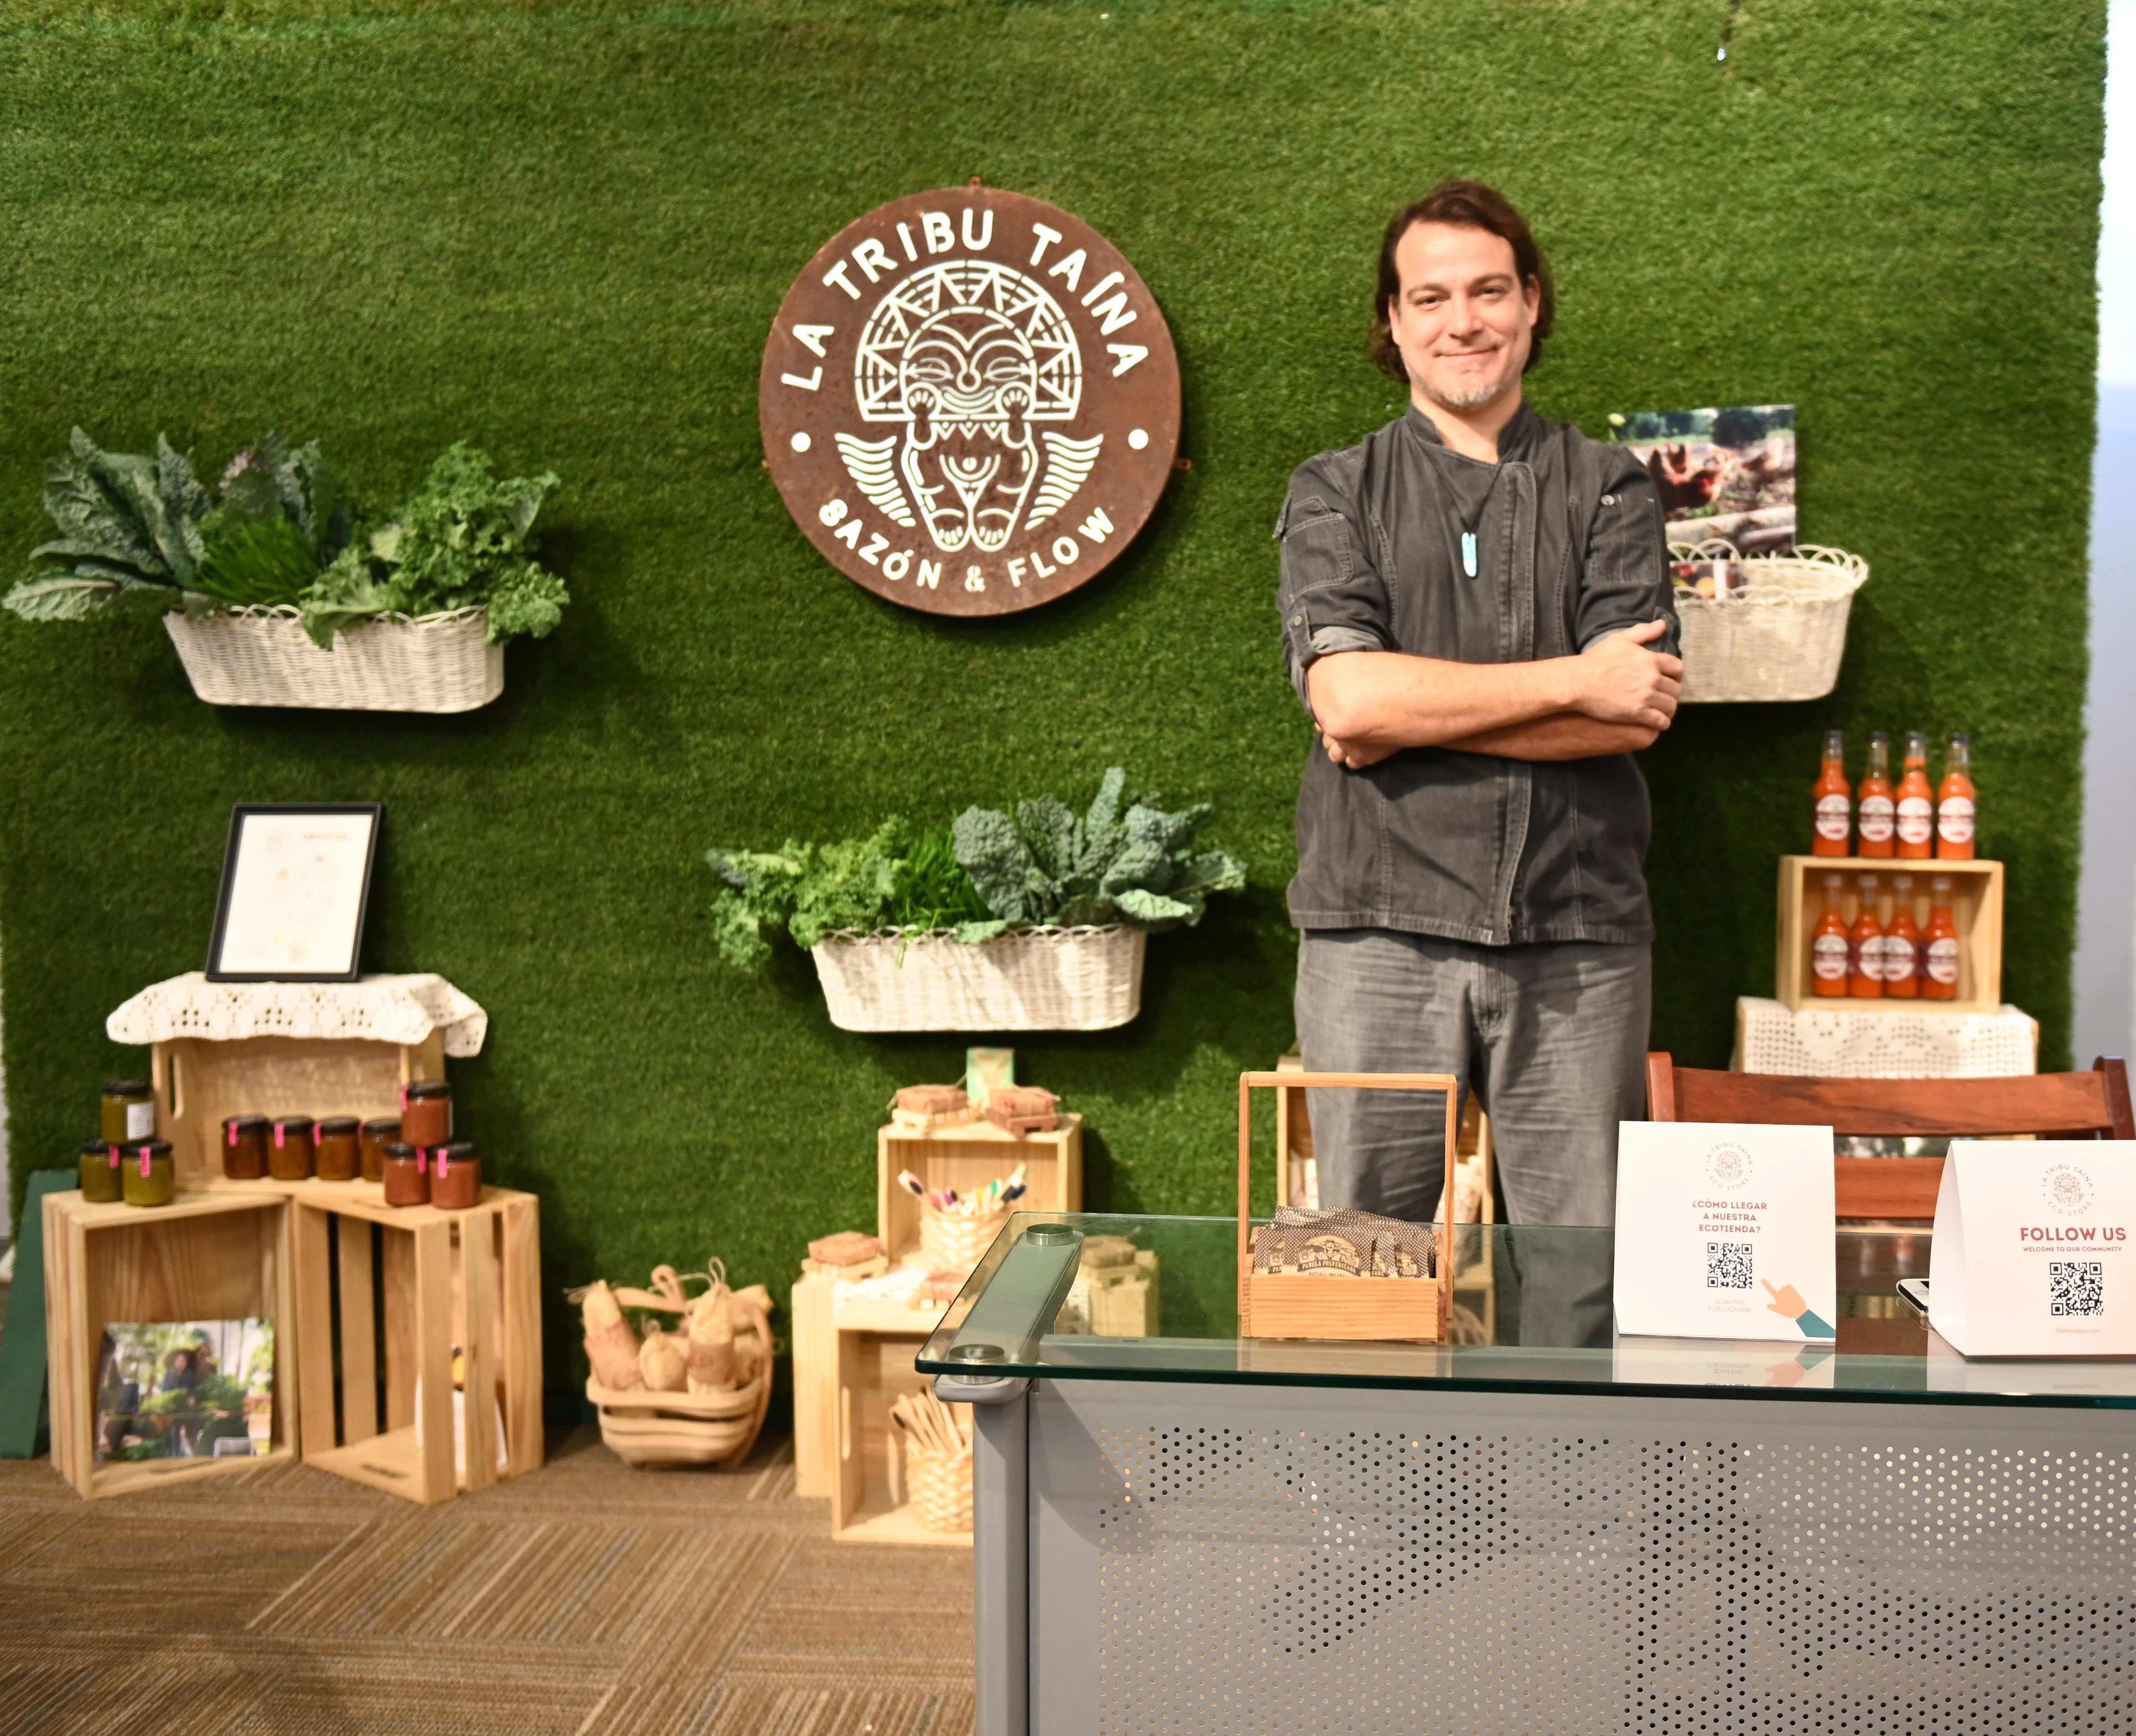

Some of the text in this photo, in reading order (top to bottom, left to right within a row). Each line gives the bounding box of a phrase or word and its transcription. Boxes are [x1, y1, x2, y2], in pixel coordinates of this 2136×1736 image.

[781, 208, 1149, 391] LA TRIBU TAÍNA
[819, 498, 1114, 593] SAZÓN & FLOW
[1705, 1155, 1712, 1163] LA
[1711, 1142, 1734, 1152] TRIBU
[2041, 1178, 2048, 1187] LA
[2045, 1164, 2069, 1175] TRIBU
[1709, 1176, 1749, 1190] ECO STORE
[1692, 1198, 1767, 1210] ¿CÓMO LLEGAR
[2048, 1201, 2091, 1216] ECO STORE
[1699, 1224, 1760, 1233] ECOTIENDA?
[2020, 1227, 2126, 1241] FOLLOW US
[1302, 1260, 1356, 1274] PANELA PULVERIZADA
